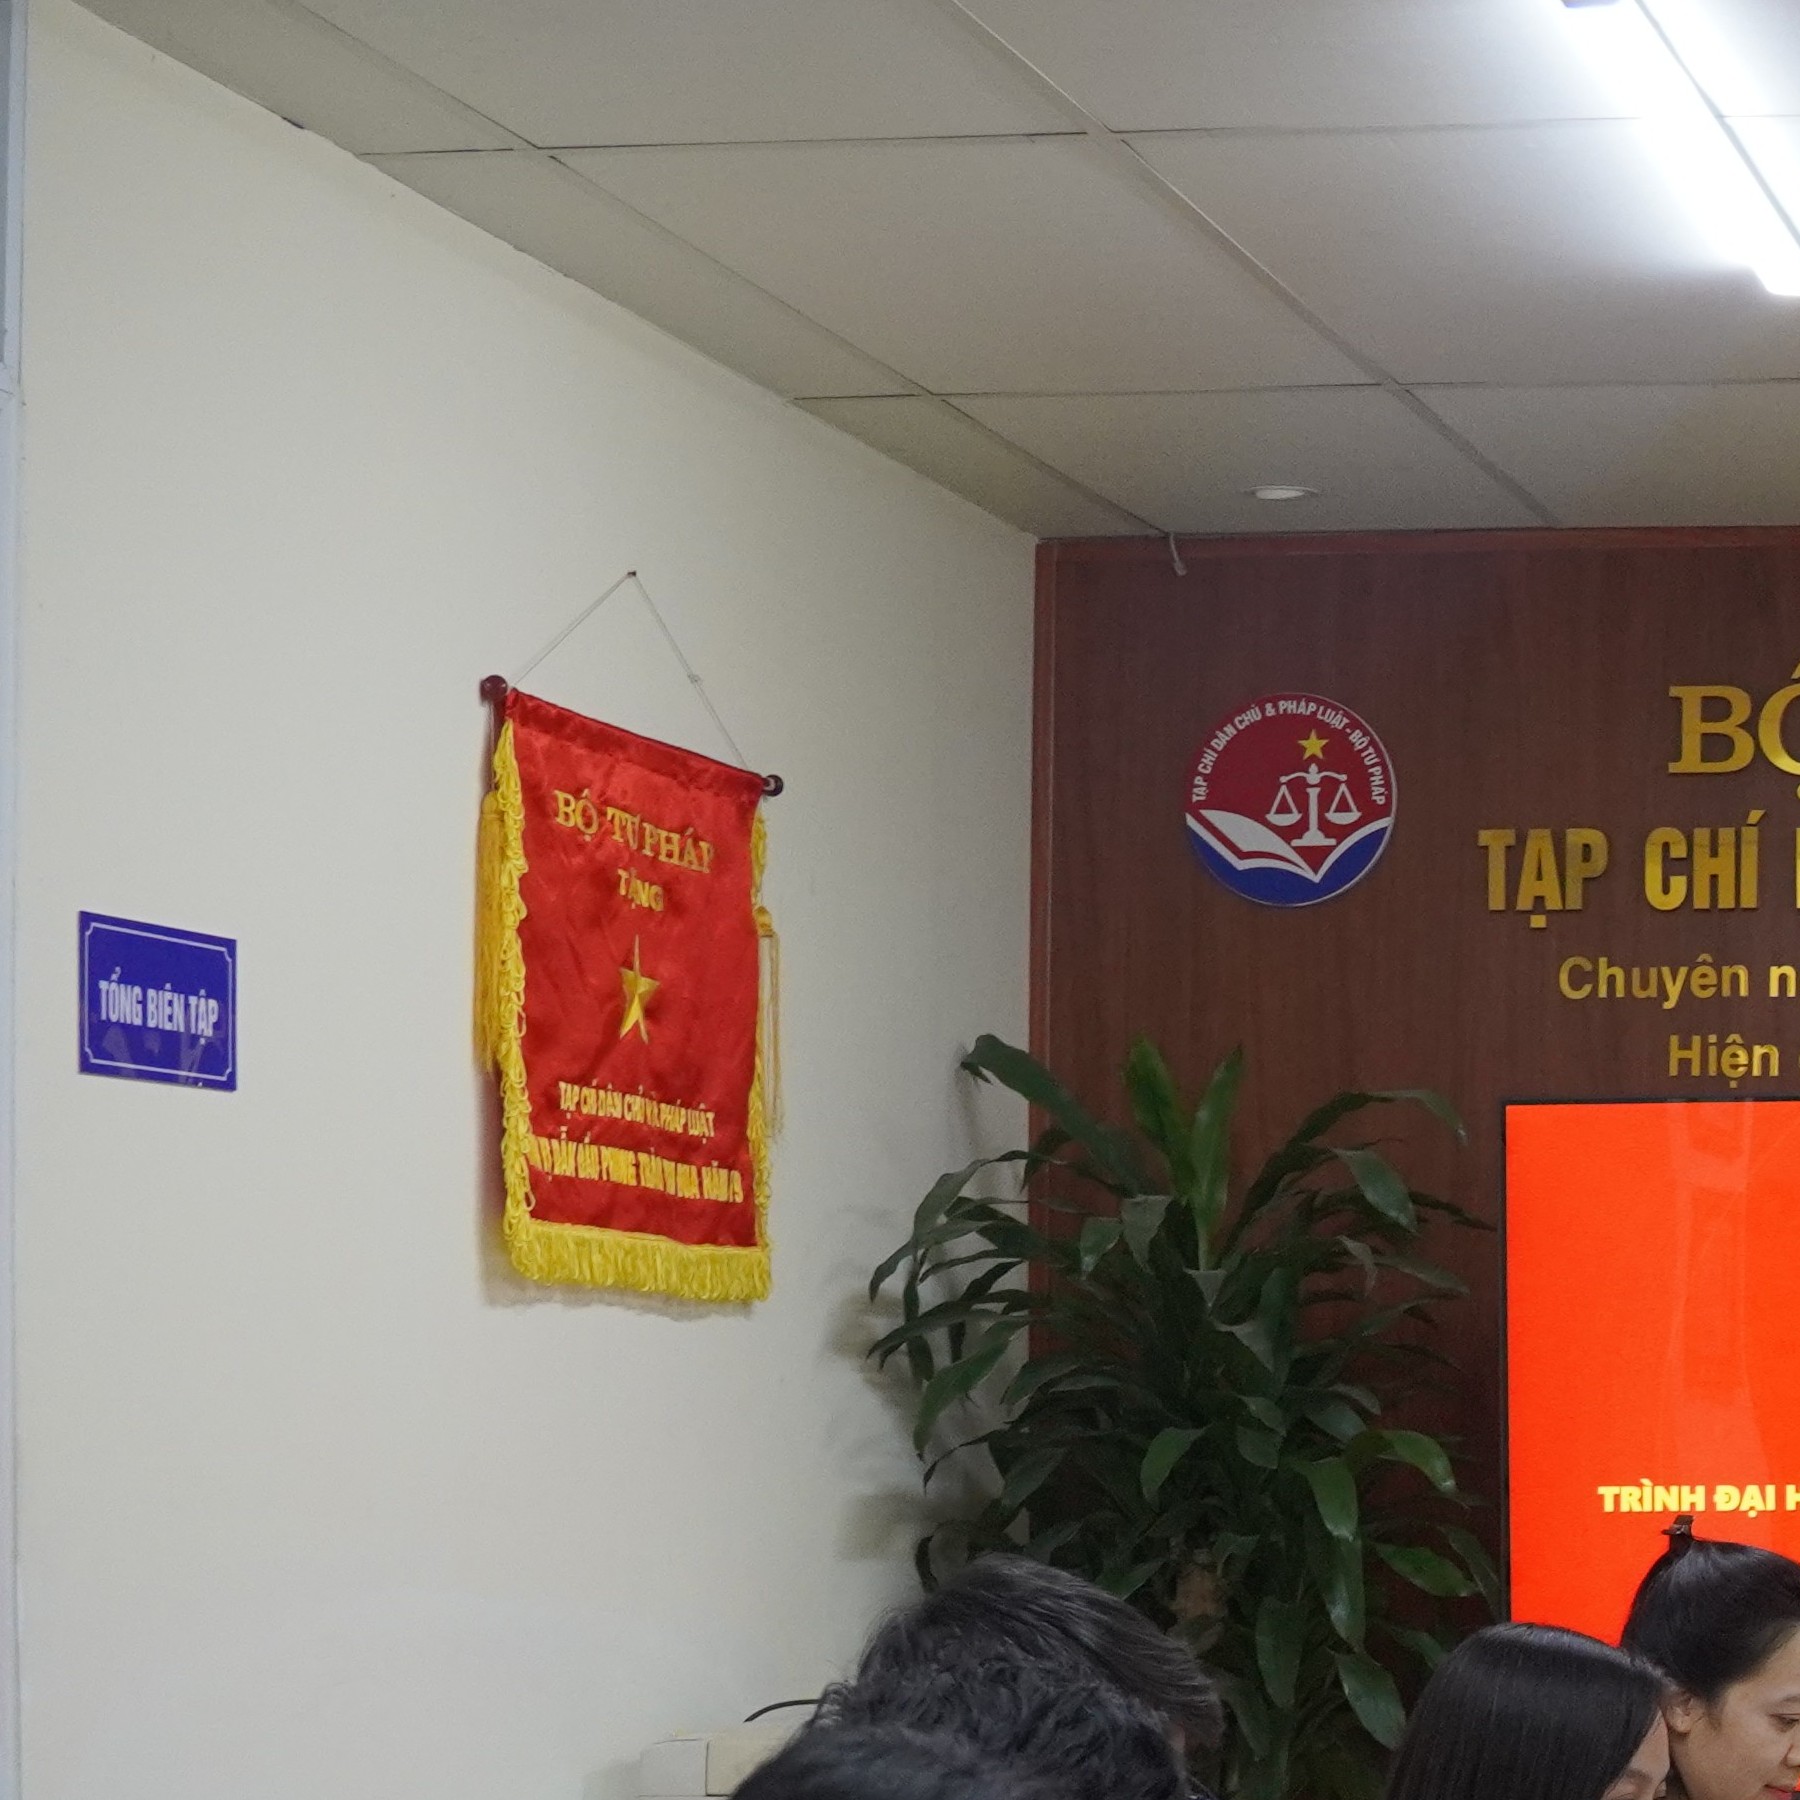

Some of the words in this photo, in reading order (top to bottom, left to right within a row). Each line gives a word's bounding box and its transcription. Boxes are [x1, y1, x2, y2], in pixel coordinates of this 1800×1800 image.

[1278, 698, 1318, 715] PHÁP
[1317, 705, 1351, 731] LUẬT
[1361, 747, 1381, 764] TƯ
[1192, 775, 1208, 803] TẠP
[1367, 763, 1386, 806] PHÁP
[553, 788, 599, 842] BỘ
[606, 806, 640, 850] TƯ
[641, 827, 714, 874] PHÁP
[1477, 828, 1609, 930] TẠP
[1644, 809, 1767, 911] CHÍ
[1558, 953, 1750, 1010] Chuyên
[99, 966, 143, 1026] TỔNG
[147, 983, 185, 1033] BIÊN
[188, 989, 219, 1045] TẬP
[1668, 1033, 1780, 1089] Hiện
[1597, 1477, 1707, 1514] TRÌNH
[1712, 1484, 1776, 1518] ĐẠI
